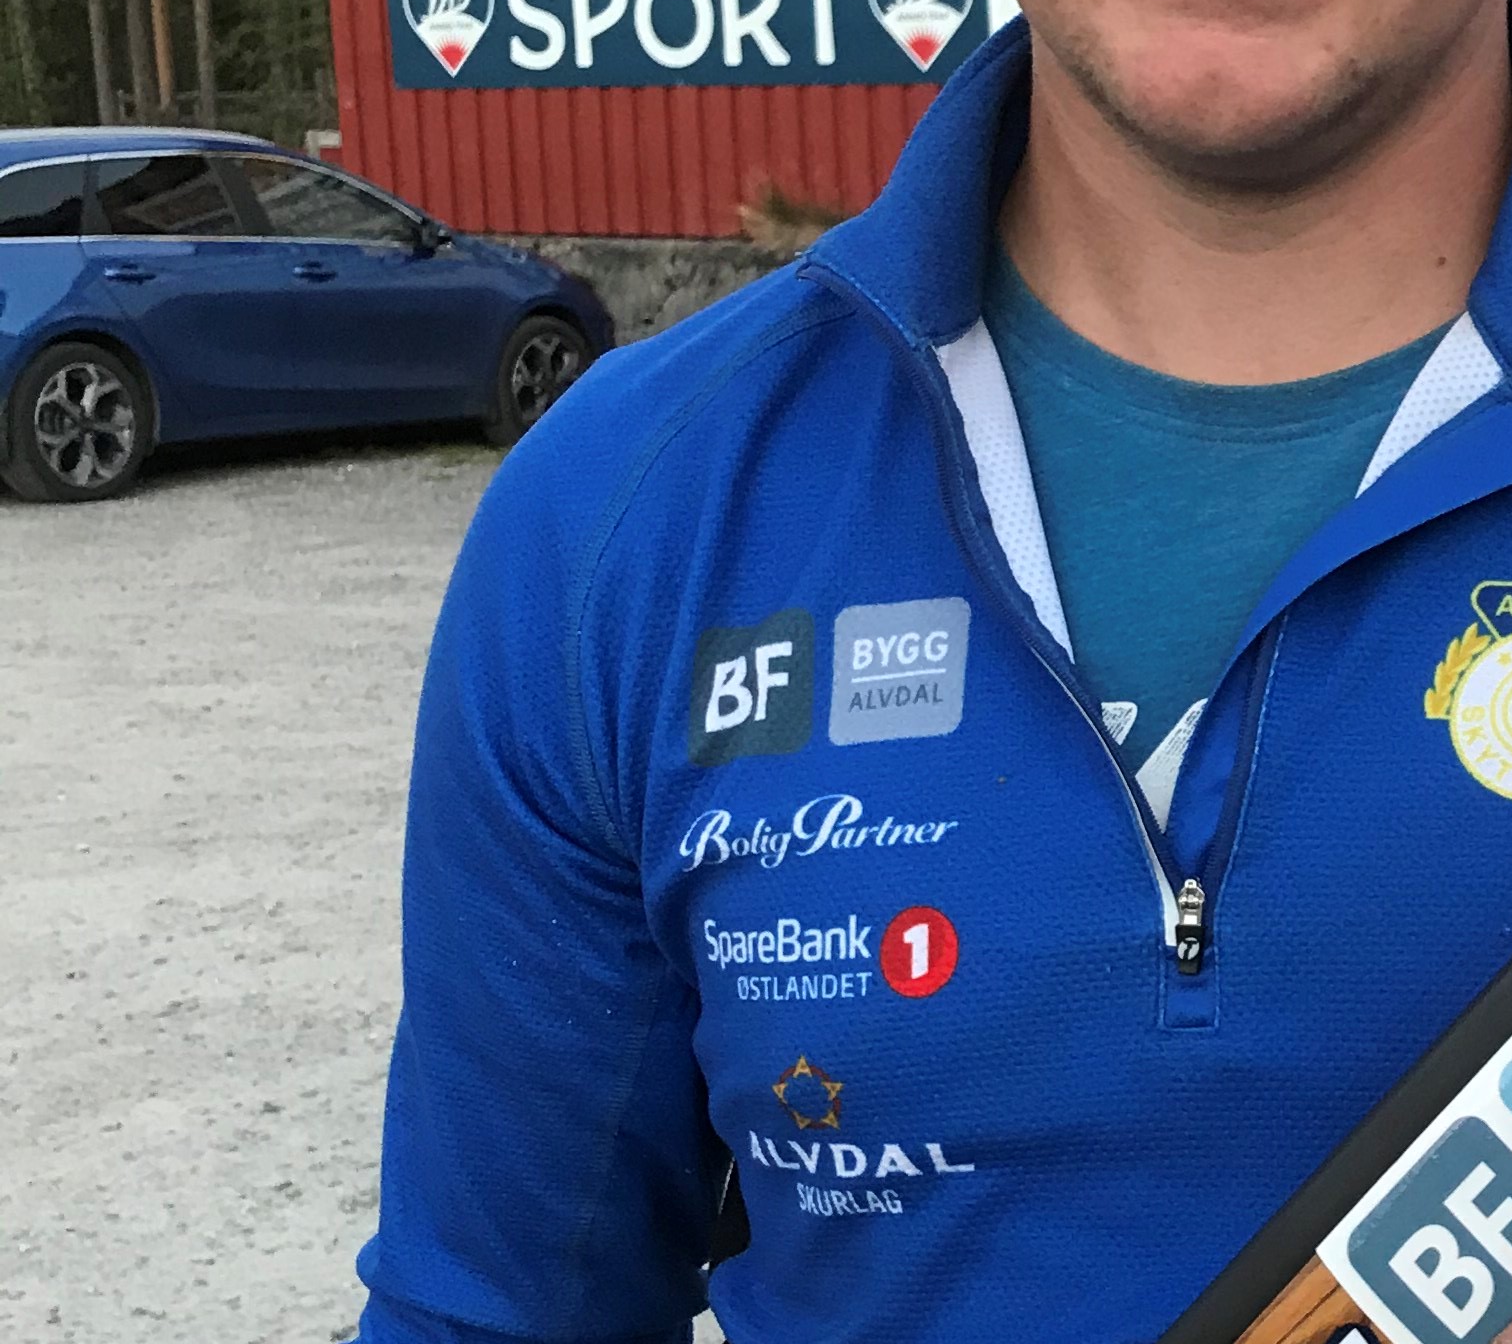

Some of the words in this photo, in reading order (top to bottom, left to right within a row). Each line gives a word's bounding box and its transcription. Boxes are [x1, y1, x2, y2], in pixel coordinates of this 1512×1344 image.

[852, 630, 950, 671] BYGG
[705, 641, 793, 733] BF
[848, 682, 944, 713] ALVDAL
[704, 914, 872, 969] SpareBank
[903, 923, 929, 979] 1
[737, 971, 873, 1001] ØSTLANDET
[749, 1130, 976, 1178] ALVDAL
[796, 1182, 903, 1216] SKURLAG
